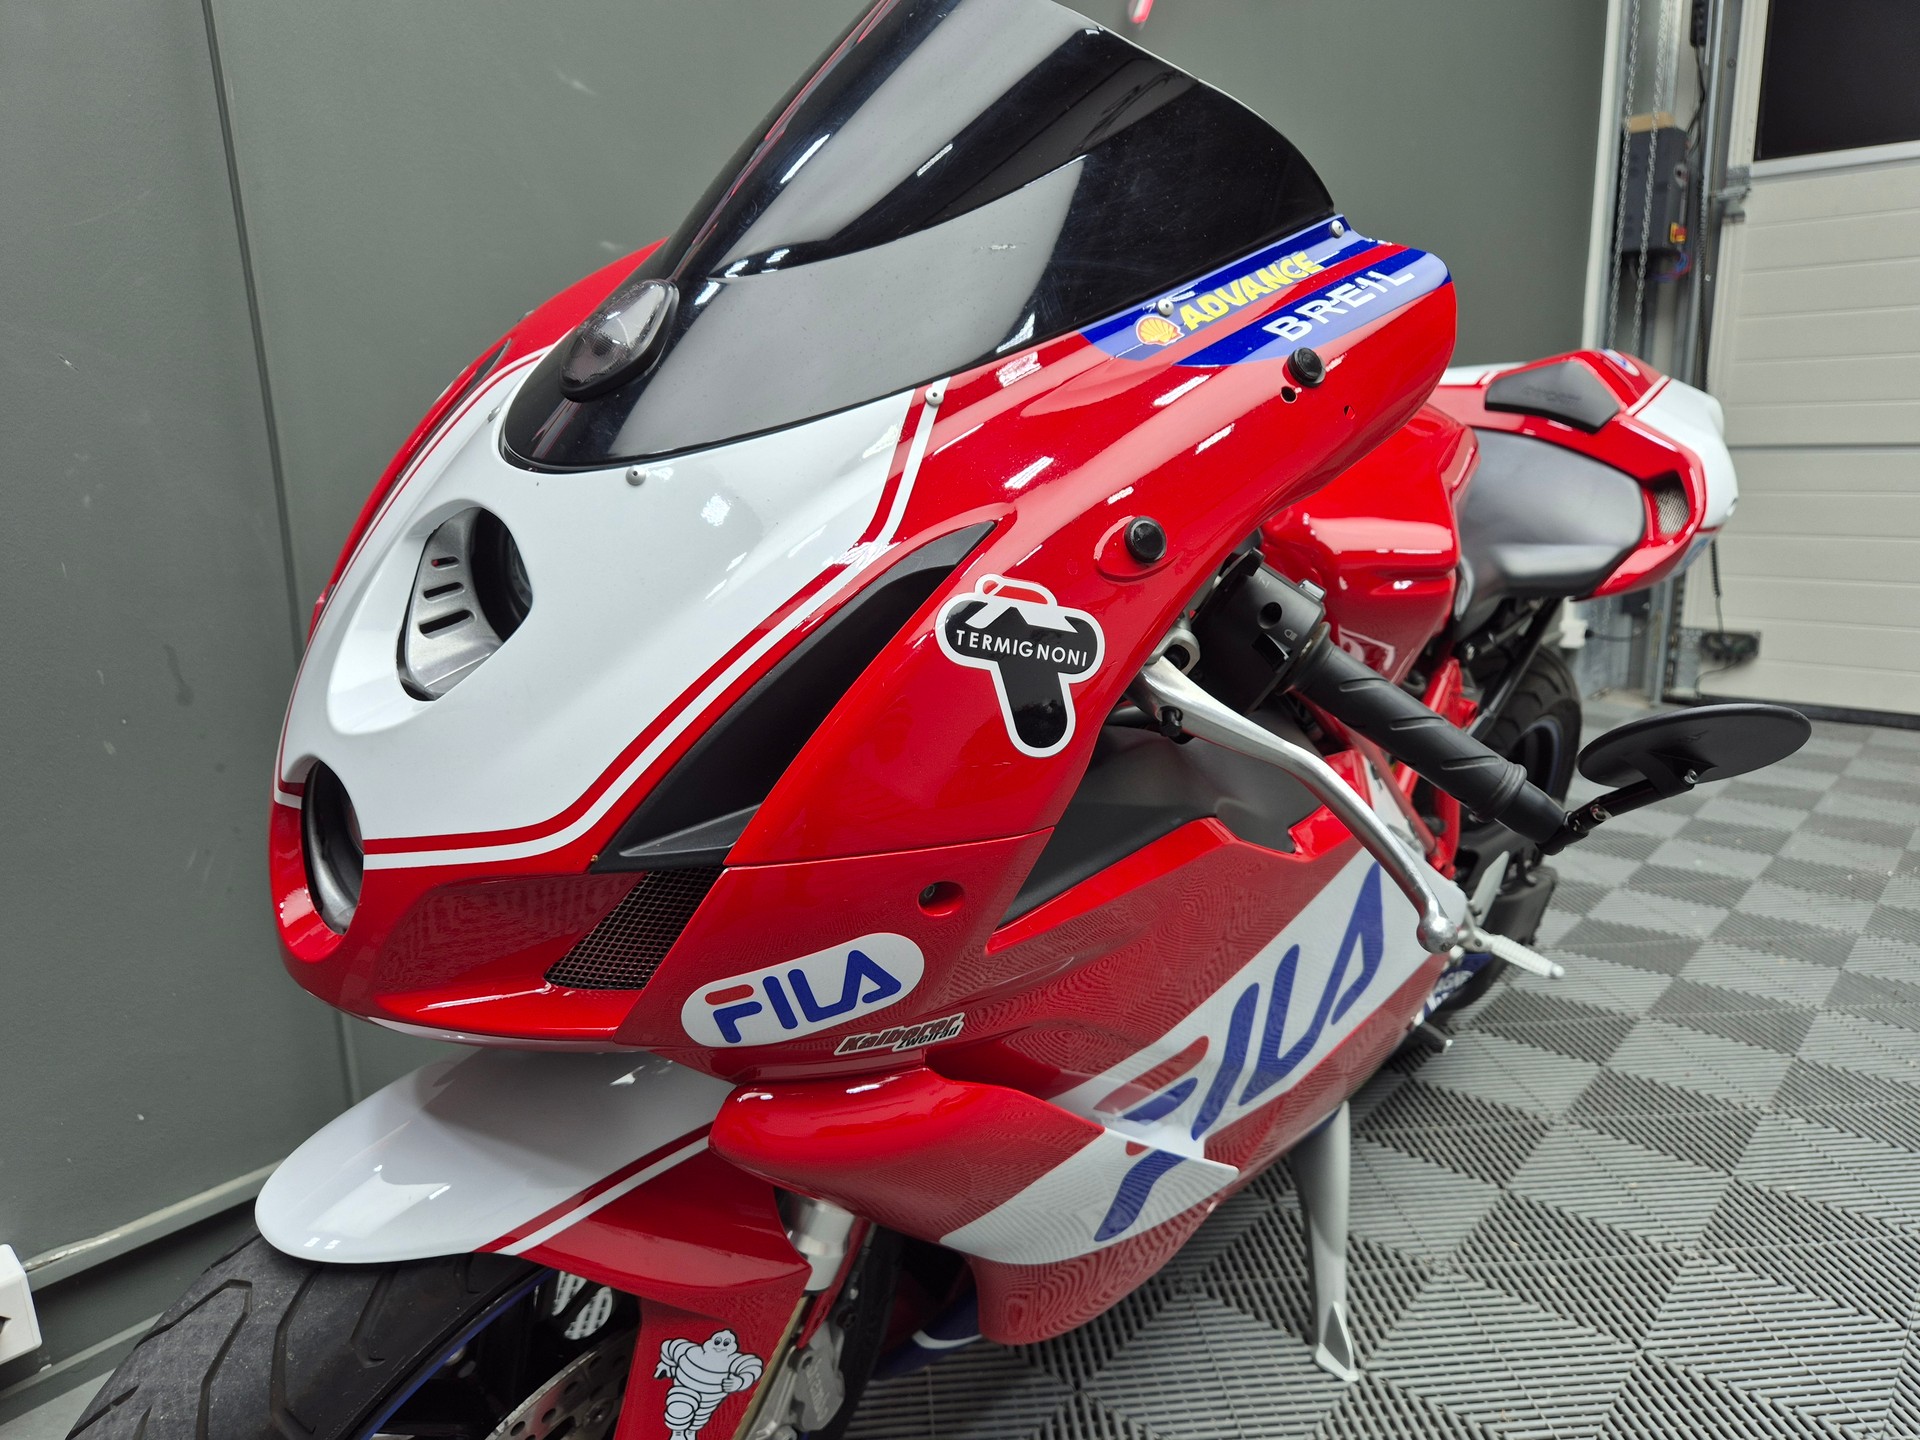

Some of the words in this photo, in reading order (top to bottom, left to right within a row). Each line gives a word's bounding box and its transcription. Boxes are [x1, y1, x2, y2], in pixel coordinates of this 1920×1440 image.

[1179, 251, 1324, 330] ADVANCE
[1262, 269, 1415, 342] BREIL
[956, 629, 1088, 667] TERMIGNONI
[704, 949, 902, 1044] FILA
[1094, 861, 1385, 1242] FILA
